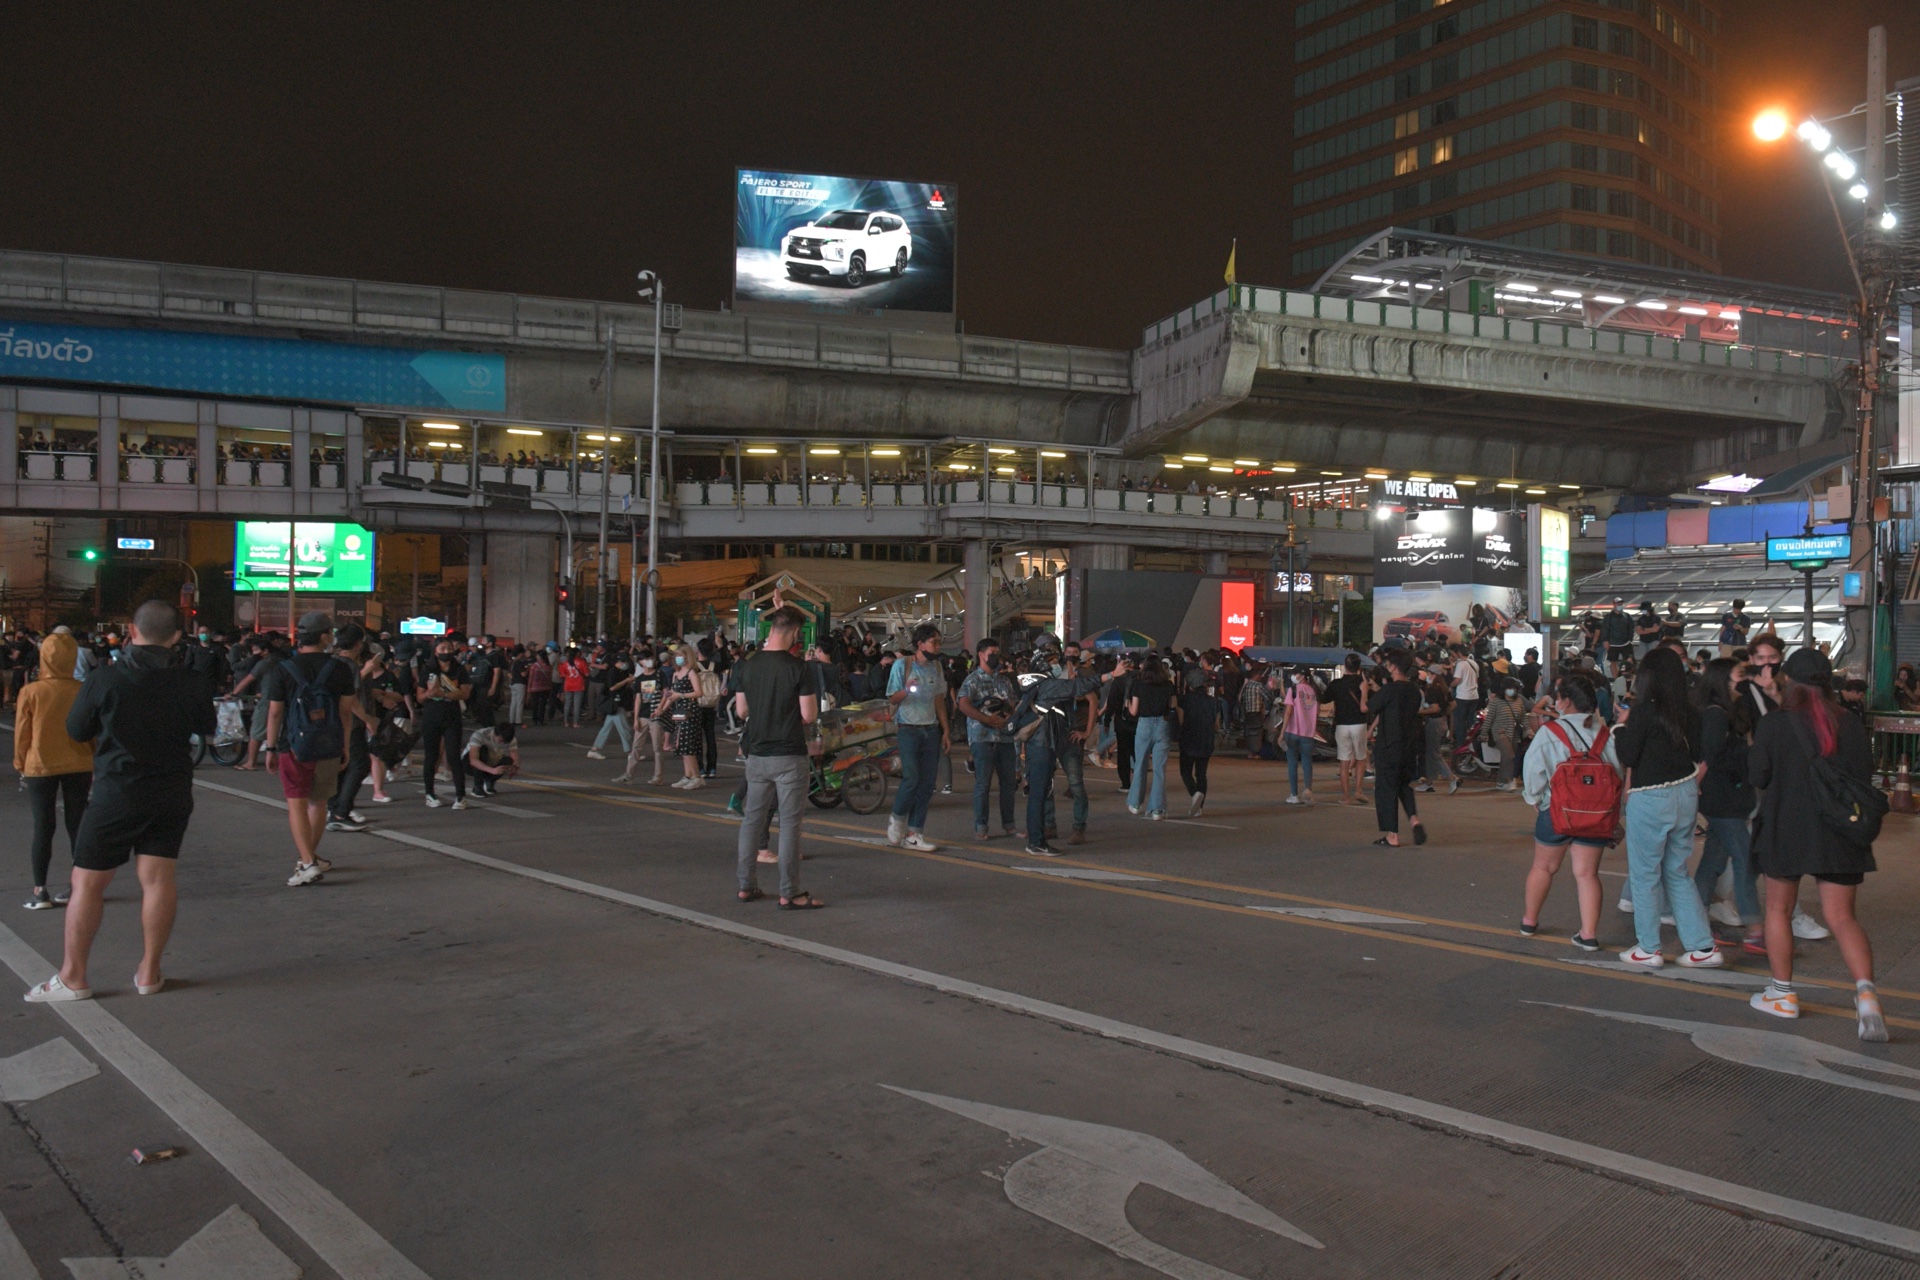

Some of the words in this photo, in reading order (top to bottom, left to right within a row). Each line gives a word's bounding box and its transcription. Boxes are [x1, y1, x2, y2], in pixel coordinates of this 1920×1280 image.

[740, 177, 777, 187] PAJERO
[779, 180, 811, 189] SPORT
[759, 187, 785, 196] ELITE
[1384, 480, 1403, 496] WE
[1404, 481, 1427, 497] ARE
[1775, 537, 1843, 551] ถนนอโศกมนตรี
